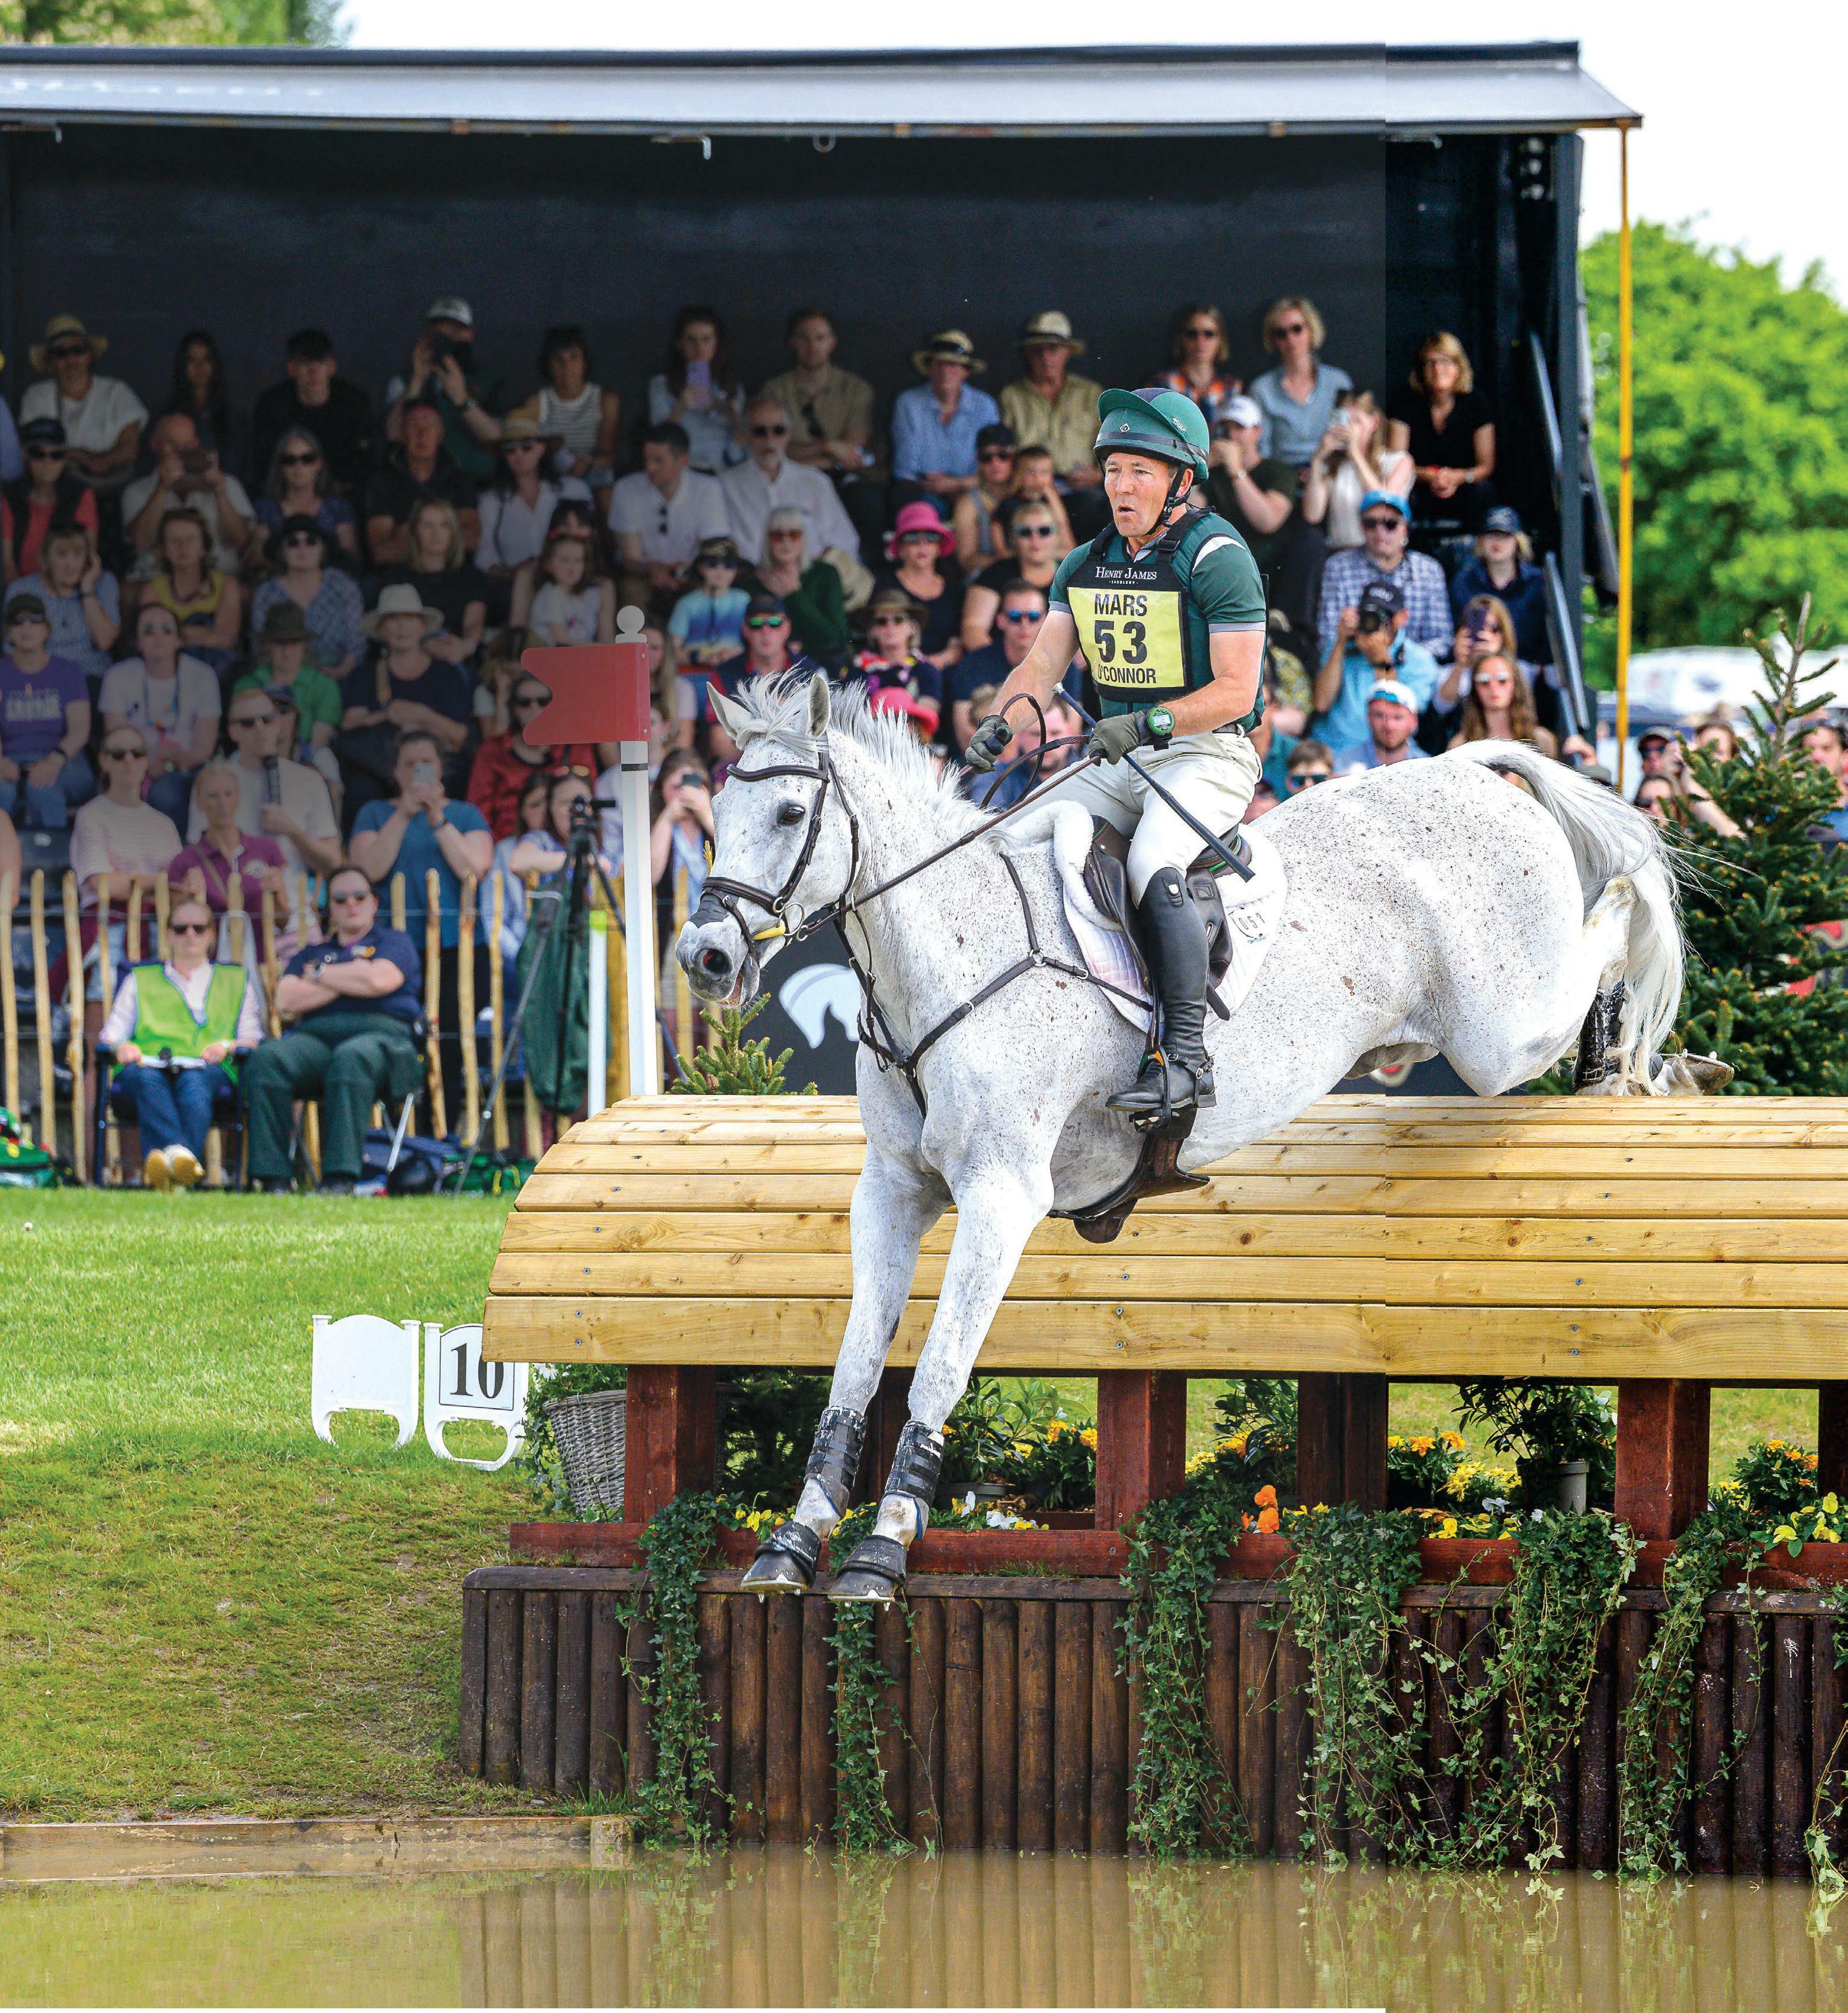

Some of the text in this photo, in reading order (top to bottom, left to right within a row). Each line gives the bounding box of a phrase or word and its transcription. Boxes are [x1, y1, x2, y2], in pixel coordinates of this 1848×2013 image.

[1095, 566, 1157, 580] HENRY JAMES
[1094, 593, 1147, 616] MARS
[1094, 620, 1147, 664] 53
[1098, 664, 1156, 684] O'CONNOR
[450, 1343, 503, 1398] 10
